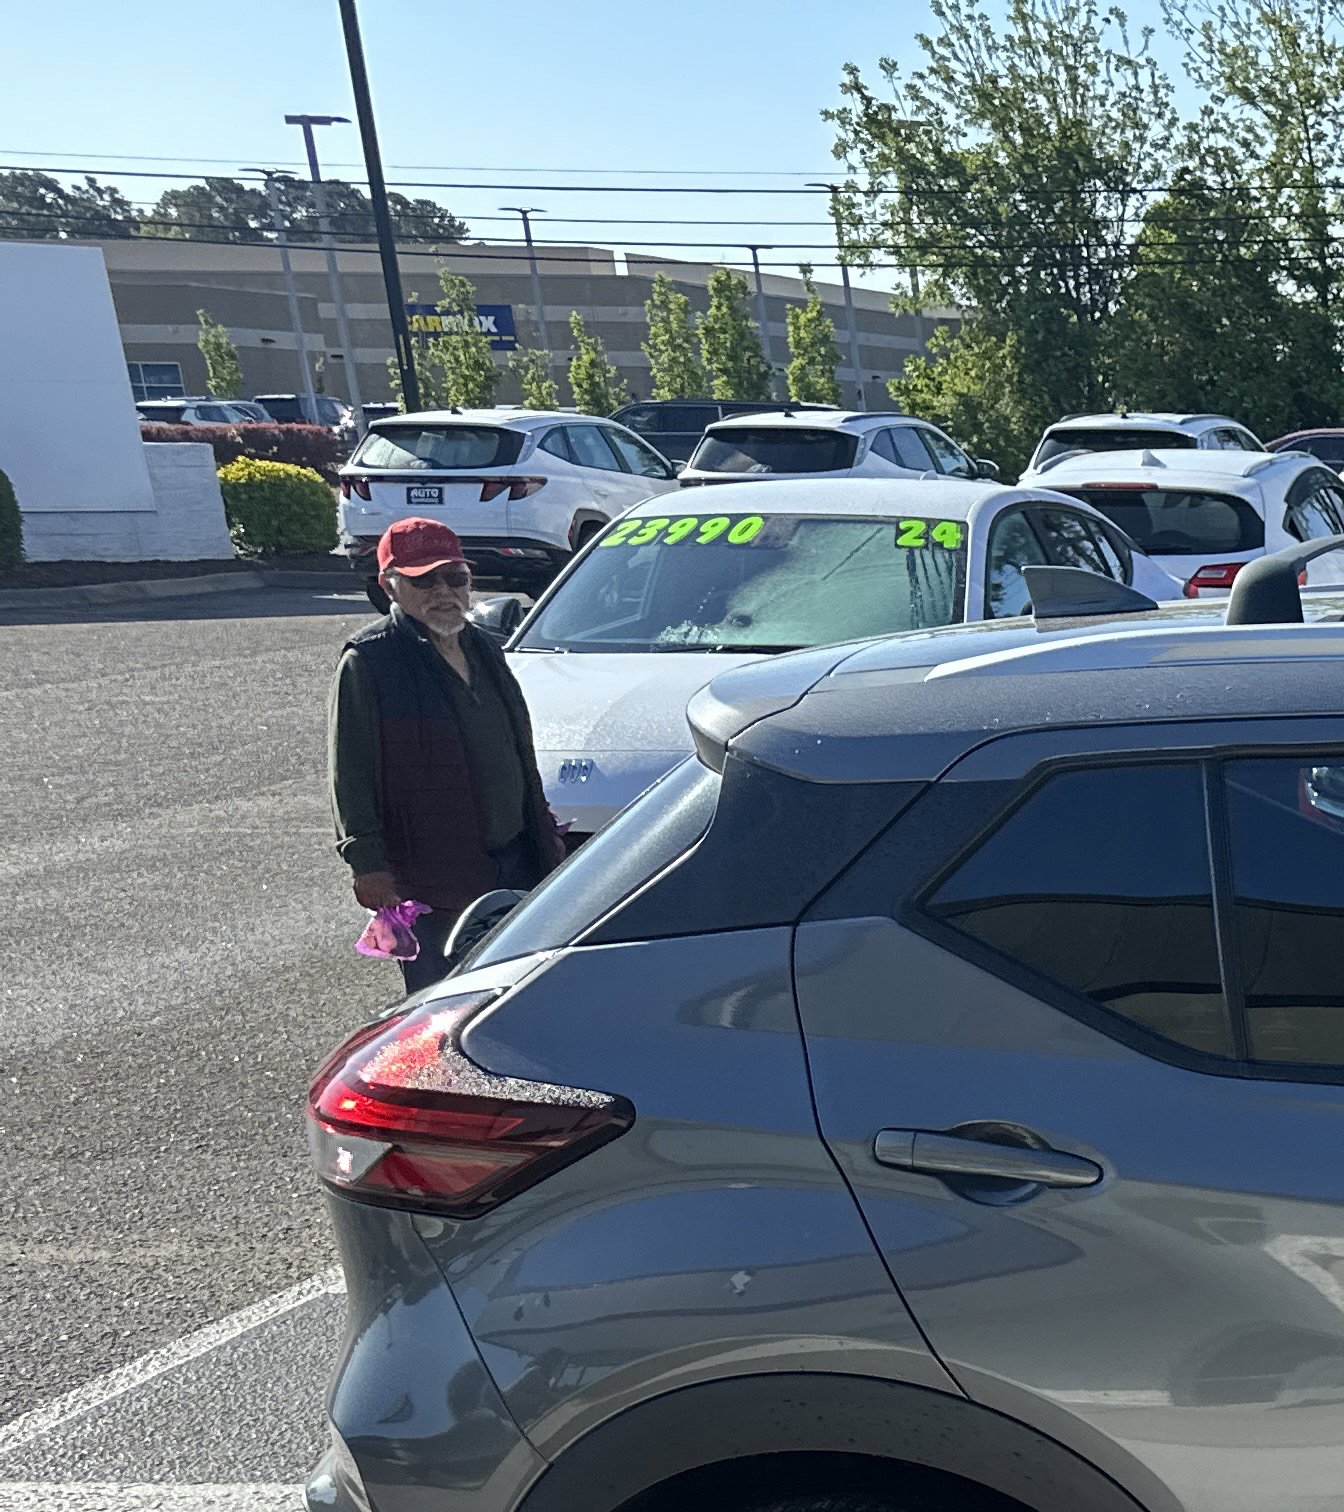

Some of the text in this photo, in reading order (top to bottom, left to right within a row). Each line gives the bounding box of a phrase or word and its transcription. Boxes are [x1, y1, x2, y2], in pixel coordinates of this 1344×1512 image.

[411, 488, 439, 498] AUTO
[600, 516, 963, 550] 23990 24
